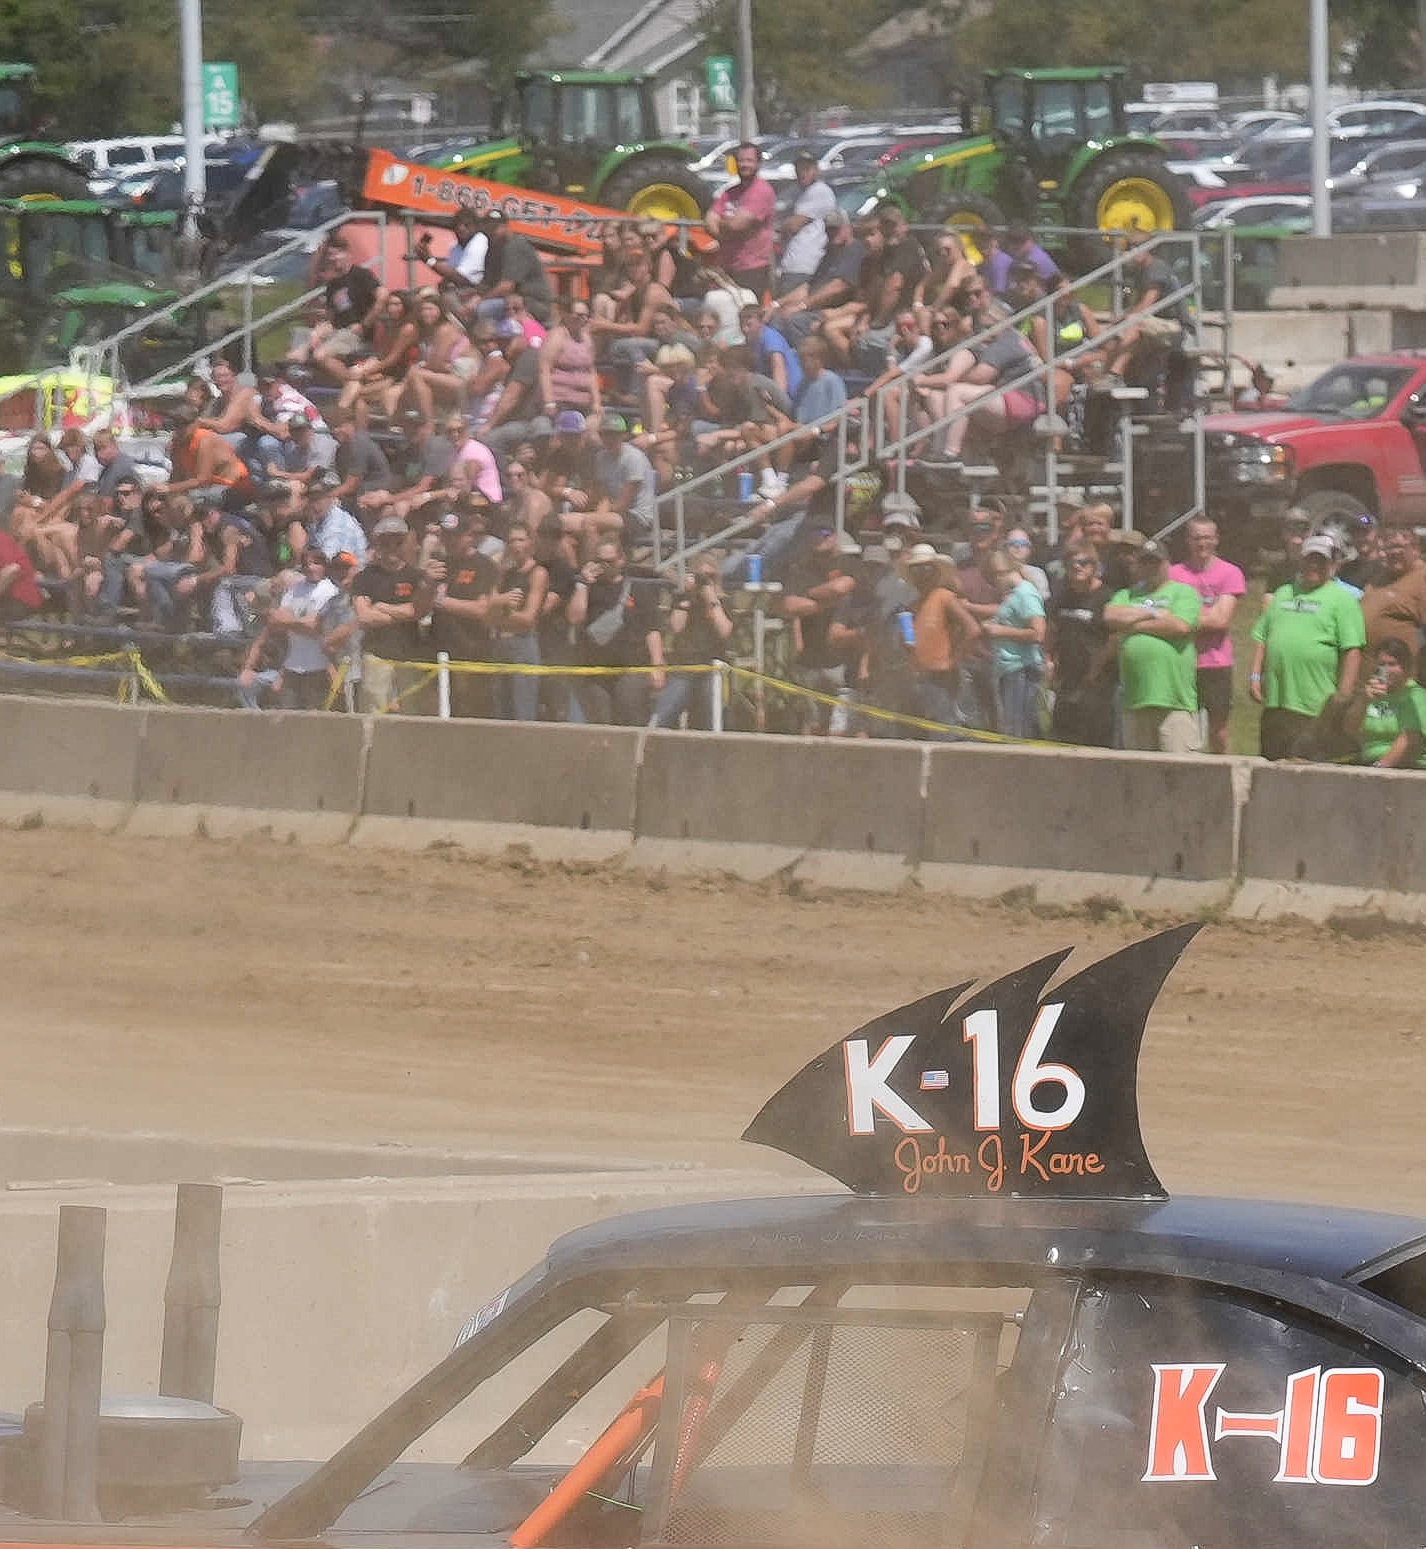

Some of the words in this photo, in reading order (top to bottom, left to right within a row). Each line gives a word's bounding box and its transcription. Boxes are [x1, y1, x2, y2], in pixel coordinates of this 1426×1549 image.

[205, 90, 234, 115] 15
[843, 1000, 1087, 1137] K-16
[893, 1133, 972, 1194] John
[1020, 1130, 1106, 1182] Kane
[1140, 1361, 1385, 1486] K-16
